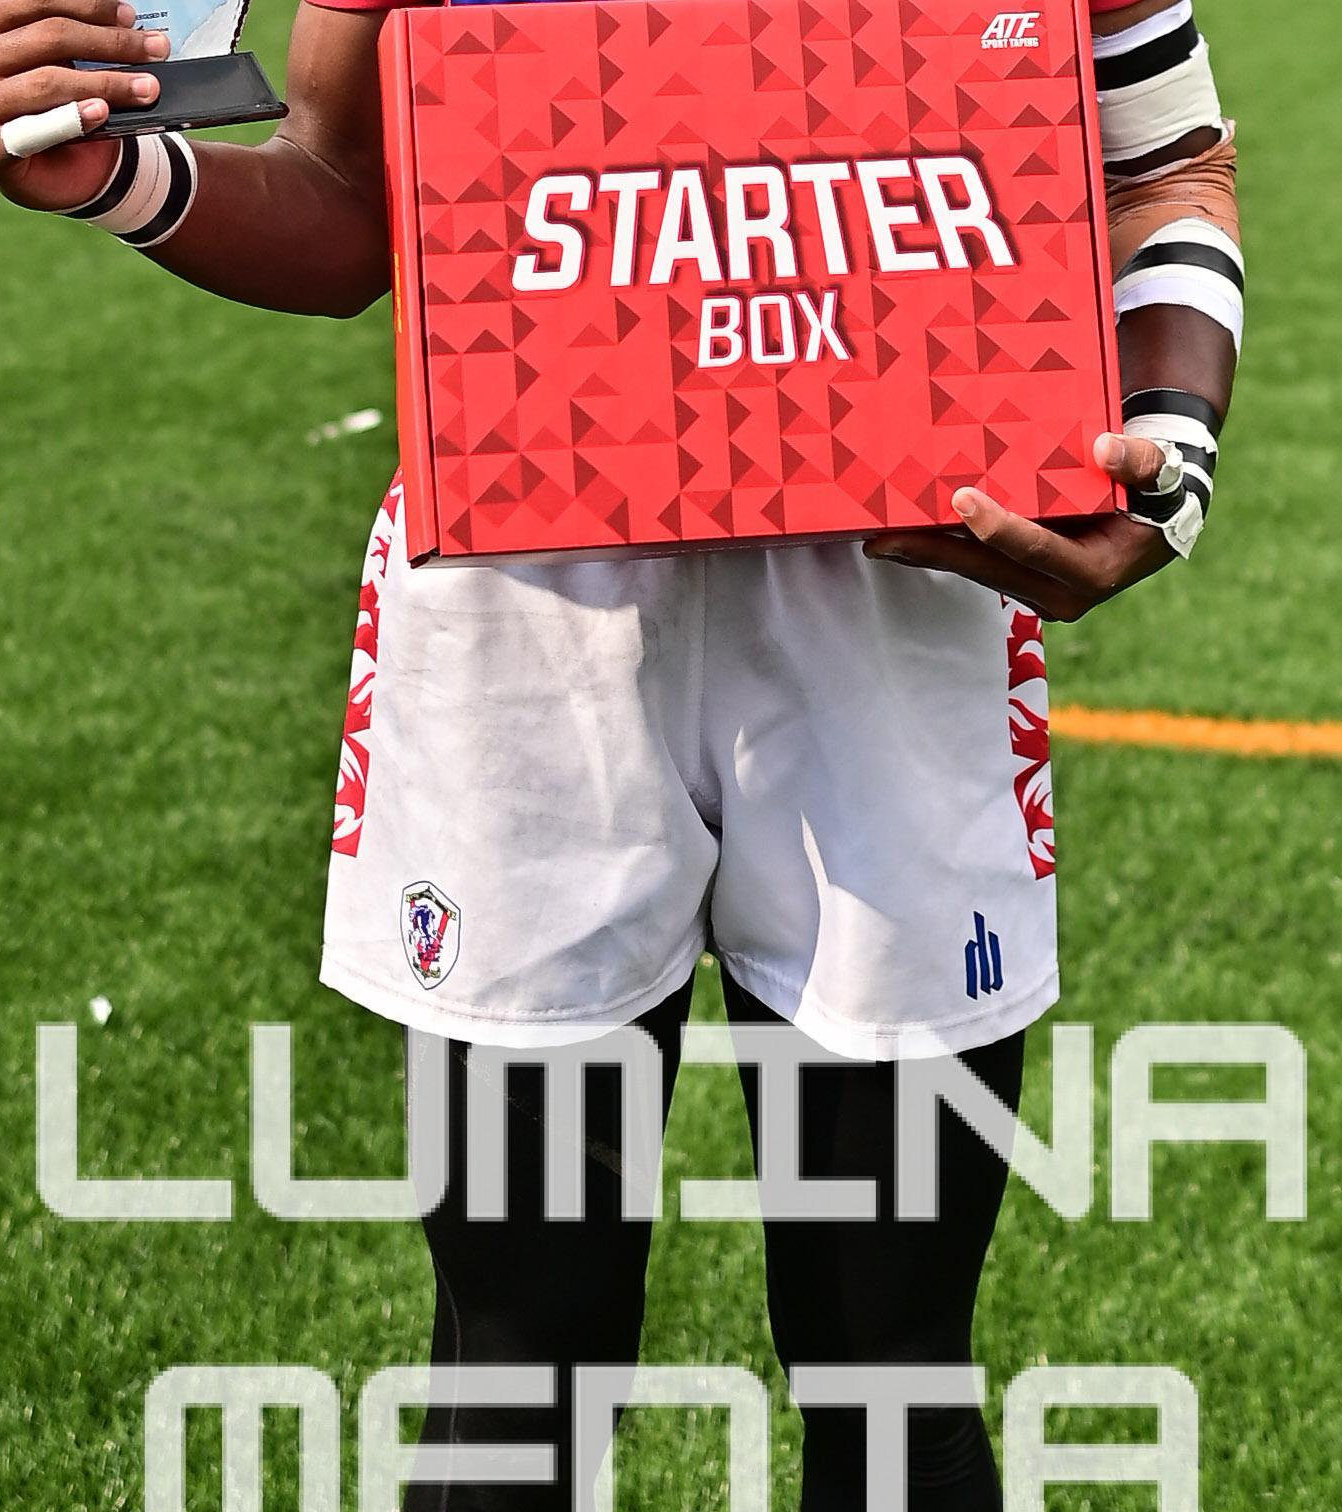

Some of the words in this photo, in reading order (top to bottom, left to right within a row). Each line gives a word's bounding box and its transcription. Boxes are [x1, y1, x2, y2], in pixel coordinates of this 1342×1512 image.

[980, 12, 1041, 39] ATF
[510, 154, 1018, 292] STARTER
[696, 290, 850, 370] BOX
